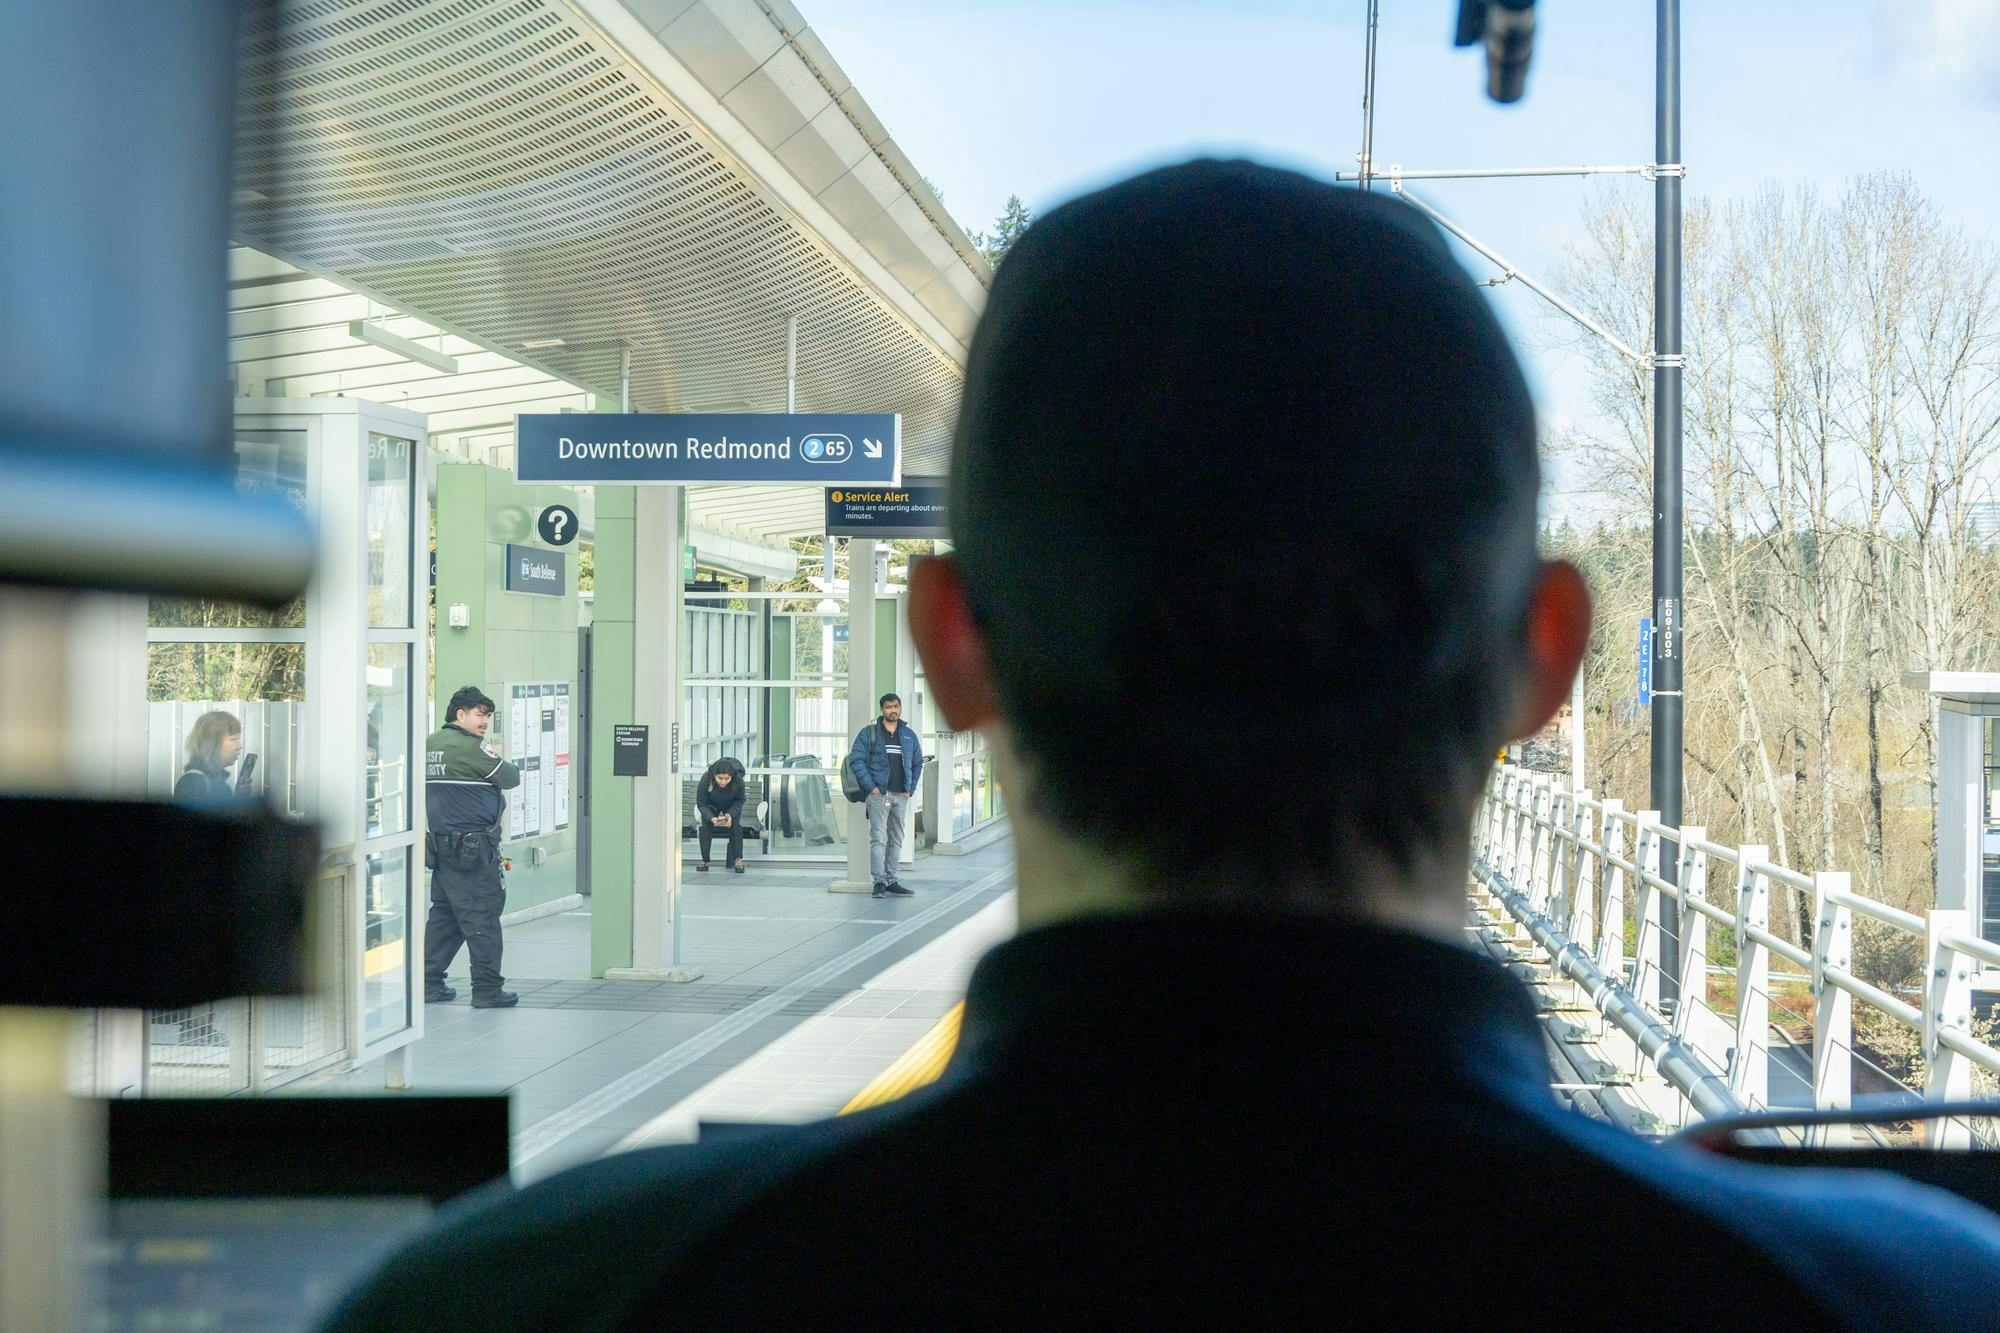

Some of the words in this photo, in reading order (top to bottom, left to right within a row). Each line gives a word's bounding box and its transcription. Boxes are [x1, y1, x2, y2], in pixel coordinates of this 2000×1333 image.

[558, 437, 678, 460] Downtown
[686, 436, 791, 460] Redmond
[808, 441, 819, 456] 2
[825, 441, 845, 456] 65
[845, 491, 881, 502] Service
[884, 491, 910, 502] Alert
[878, 504, 910, 513] departing
